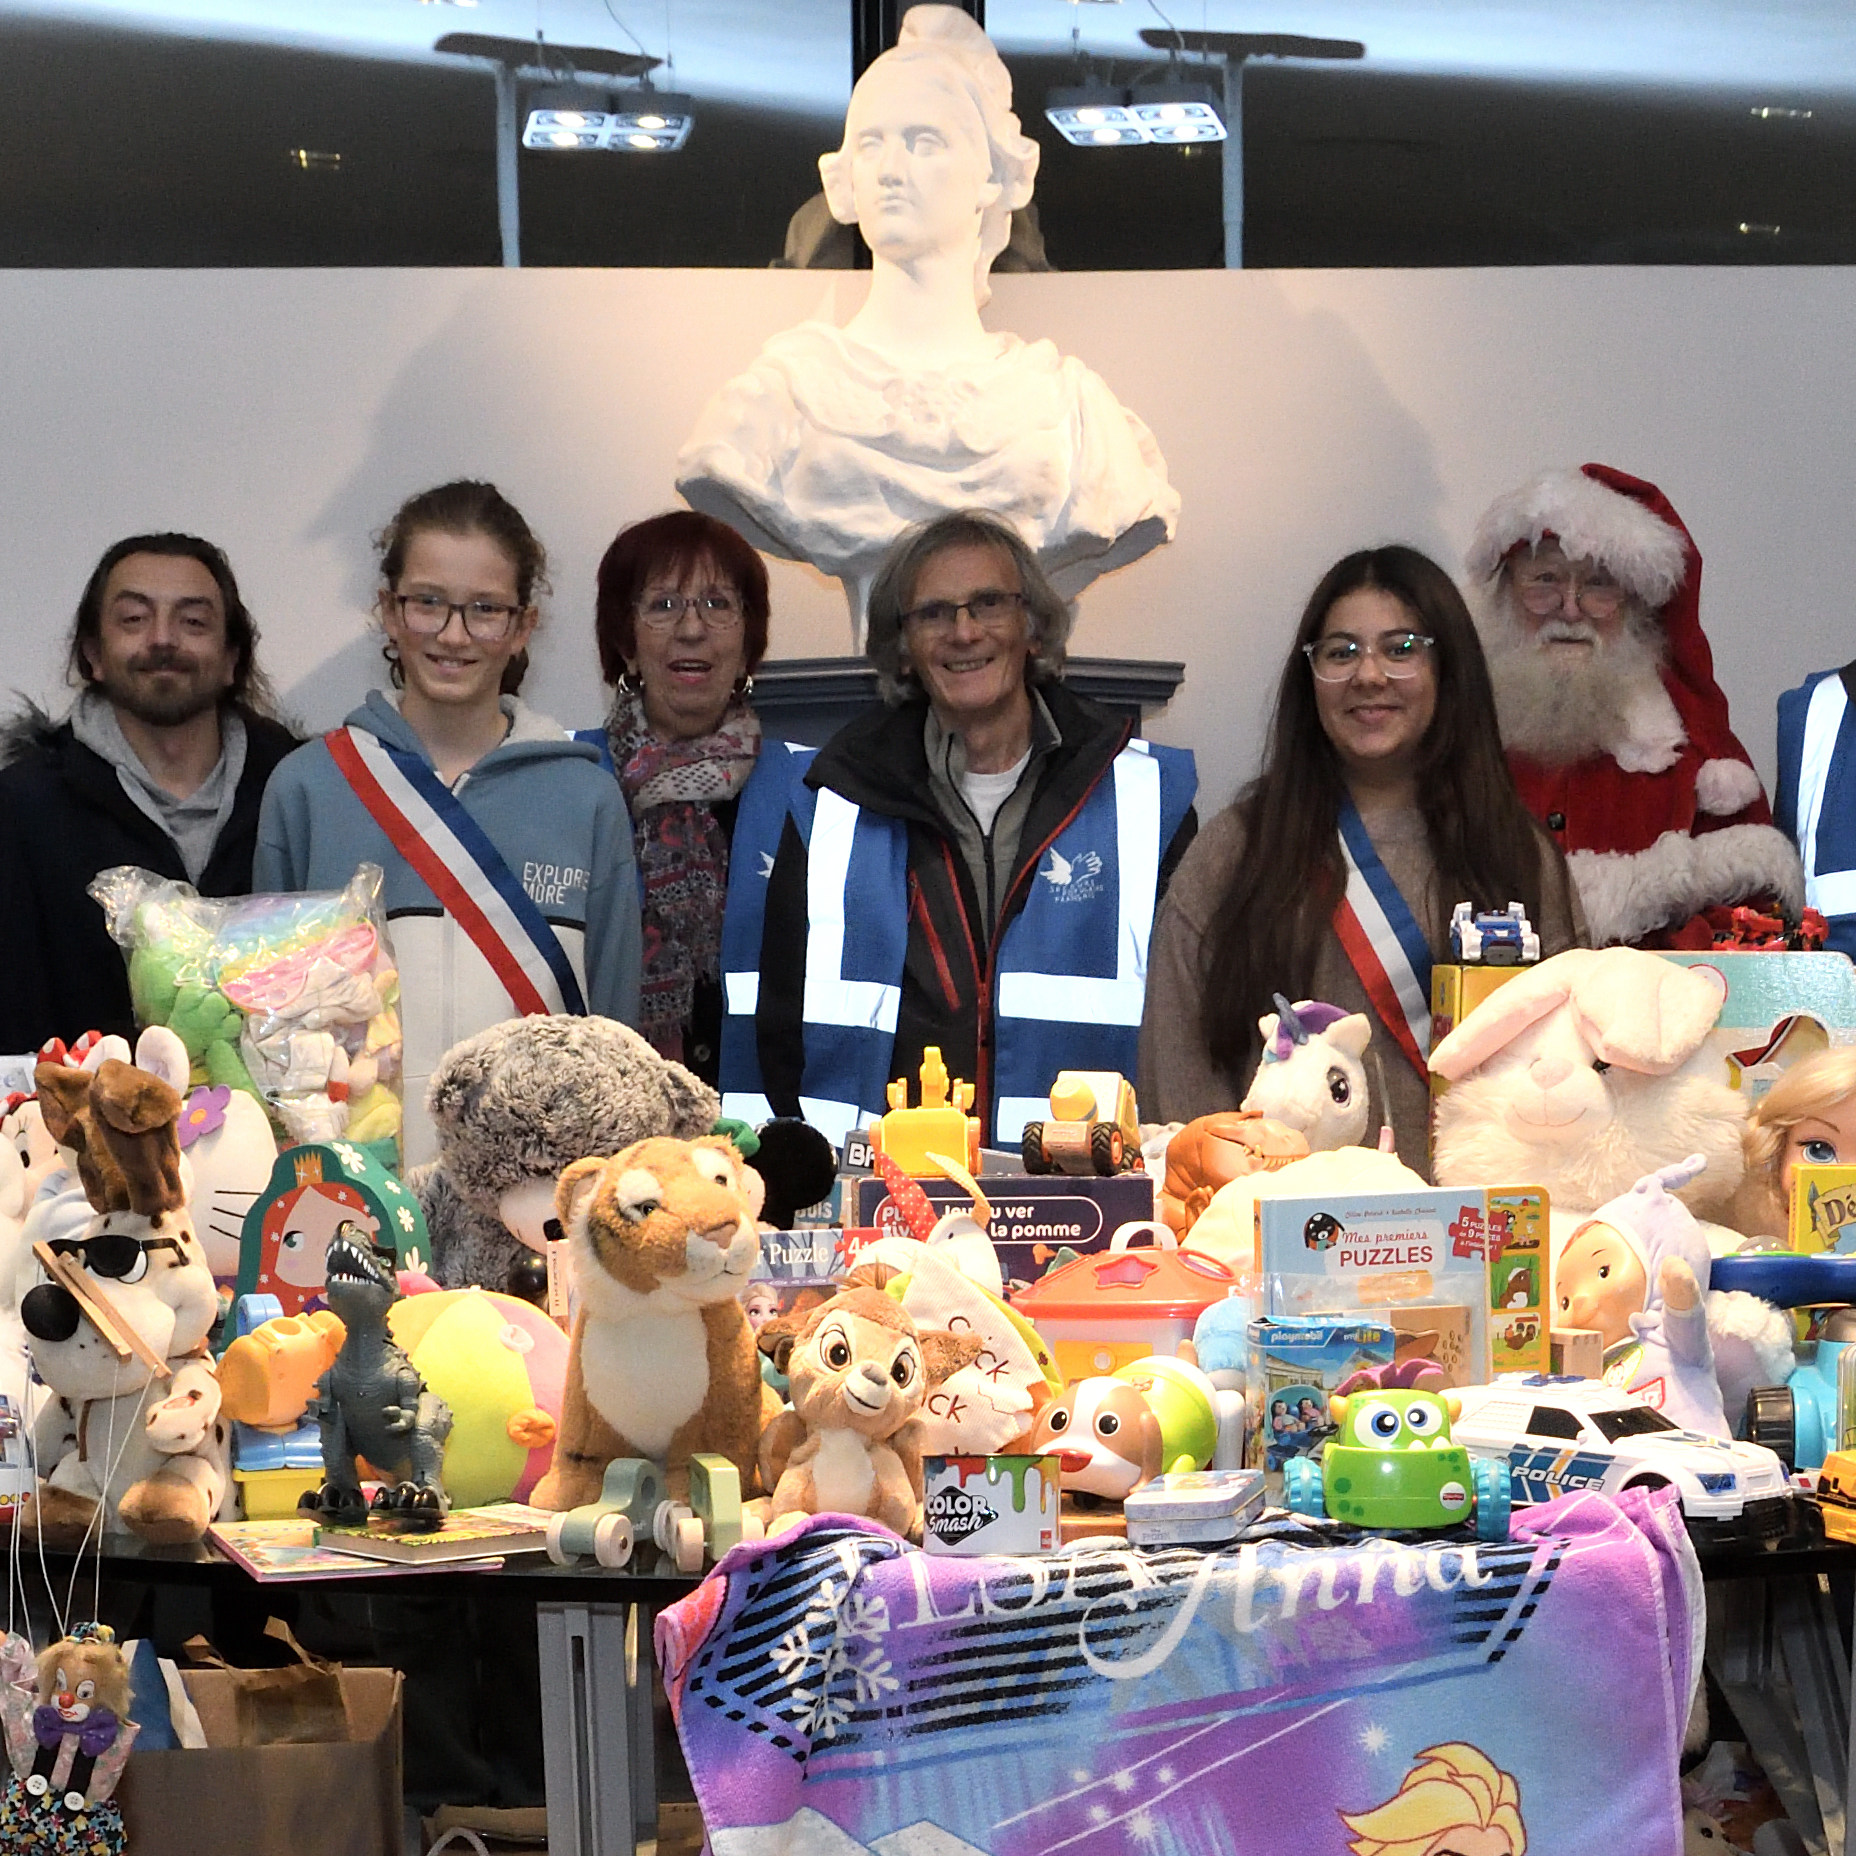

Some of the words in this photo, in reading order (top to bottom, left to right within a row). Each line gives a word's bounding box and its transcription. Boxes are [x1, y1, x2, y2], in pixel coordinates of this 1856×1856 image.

[1005, 1206, 1034, 1219] ver
[1013, 1224, 1081, 1240] pomme
[1343, 1231, 1371, 1243] Mes
[1375, 1230, 1428, 1245] premiers
[770, 1243, 829, 1266] Puzzle
[1340, 1246, 1433, 1267] PUZZLES
[1512, 1466, 1606, 1490] POLICE
[927, 1494, 988, 1515] COLOR
[928, 1512, 985, 1535] Smash
